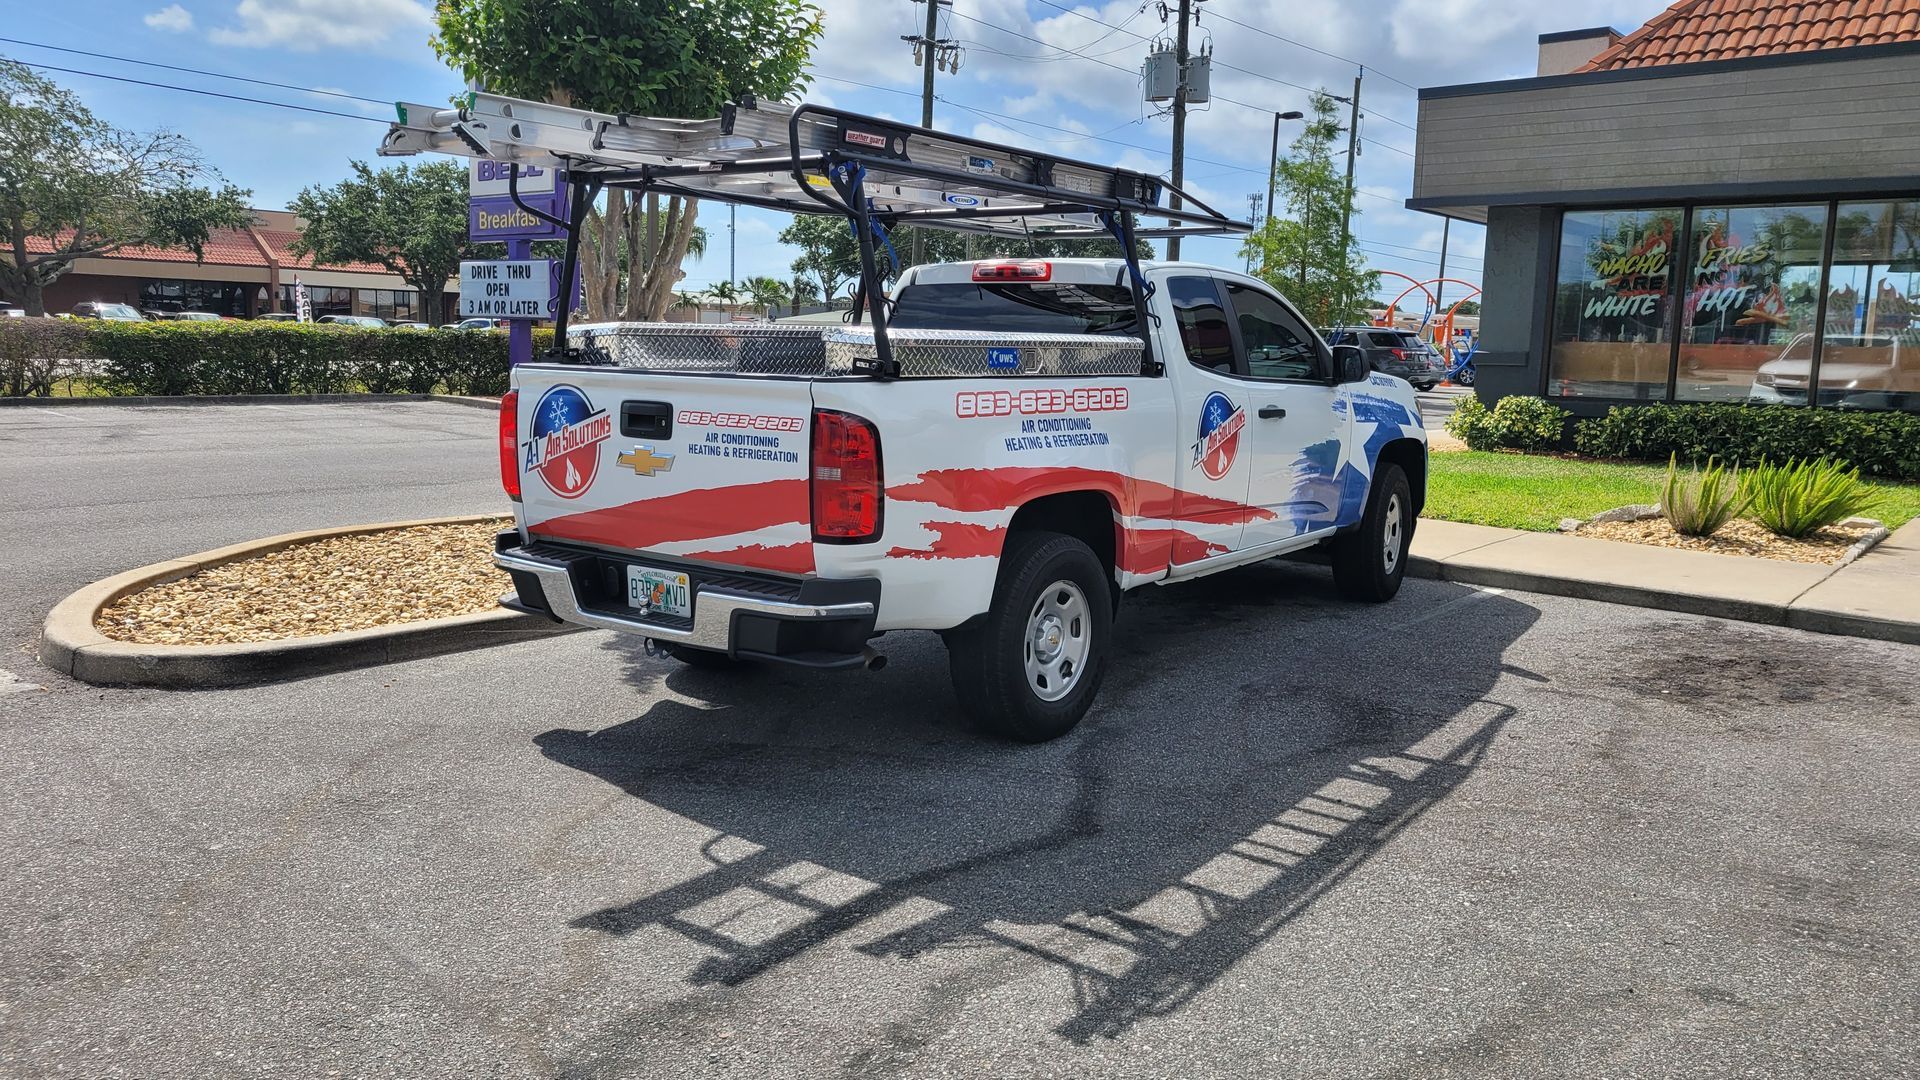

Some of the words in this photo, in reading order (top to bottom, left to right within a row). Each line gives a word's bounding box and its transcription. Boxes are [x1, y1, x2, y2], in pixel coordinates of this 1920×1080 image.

[478, 160, 544, 181] BEL
[1598, 253, 1667, 277] NACHO
[1702, 243, 1771, 268] FRIES
[471, 265, 498, 279] DRIVE
[506, 264, 531, 279] THRU
[486, 282, 510, 297] OPEN
[1618, 275, 1666, 291] ARE
[469, 301, 475, 314] 3
[478, 301, 491, 314] AM
[494, 301, 507, 315] OR
[510, 301, 539, 315] LATER
[1584, 294, 1661, 319] WHITE
[1696, 285, 1758, 312] HOT
[999, 353, 1014, 363] UWS
[956, 387, 1129, 418] 863-623-6203
[1021, 419, 1036, 433] AIR
[1037, 417, 1092, 433] CONDITIONING
[705, 432, 719, 443] AIR
[721, 433, 780, 448] CONDITIONING
[1004, 437, 1042, 452] HEATING
[1045, 437, 1052, 448] &
[1053, 432, 1109, 447] REFRIGERATION
[688, 443, 721, 456] HEATING
[723, 446, 730, 457] &
[732, 447, 798, 463] REFRIGERATION
[666, 584, 686, 607] MVD
